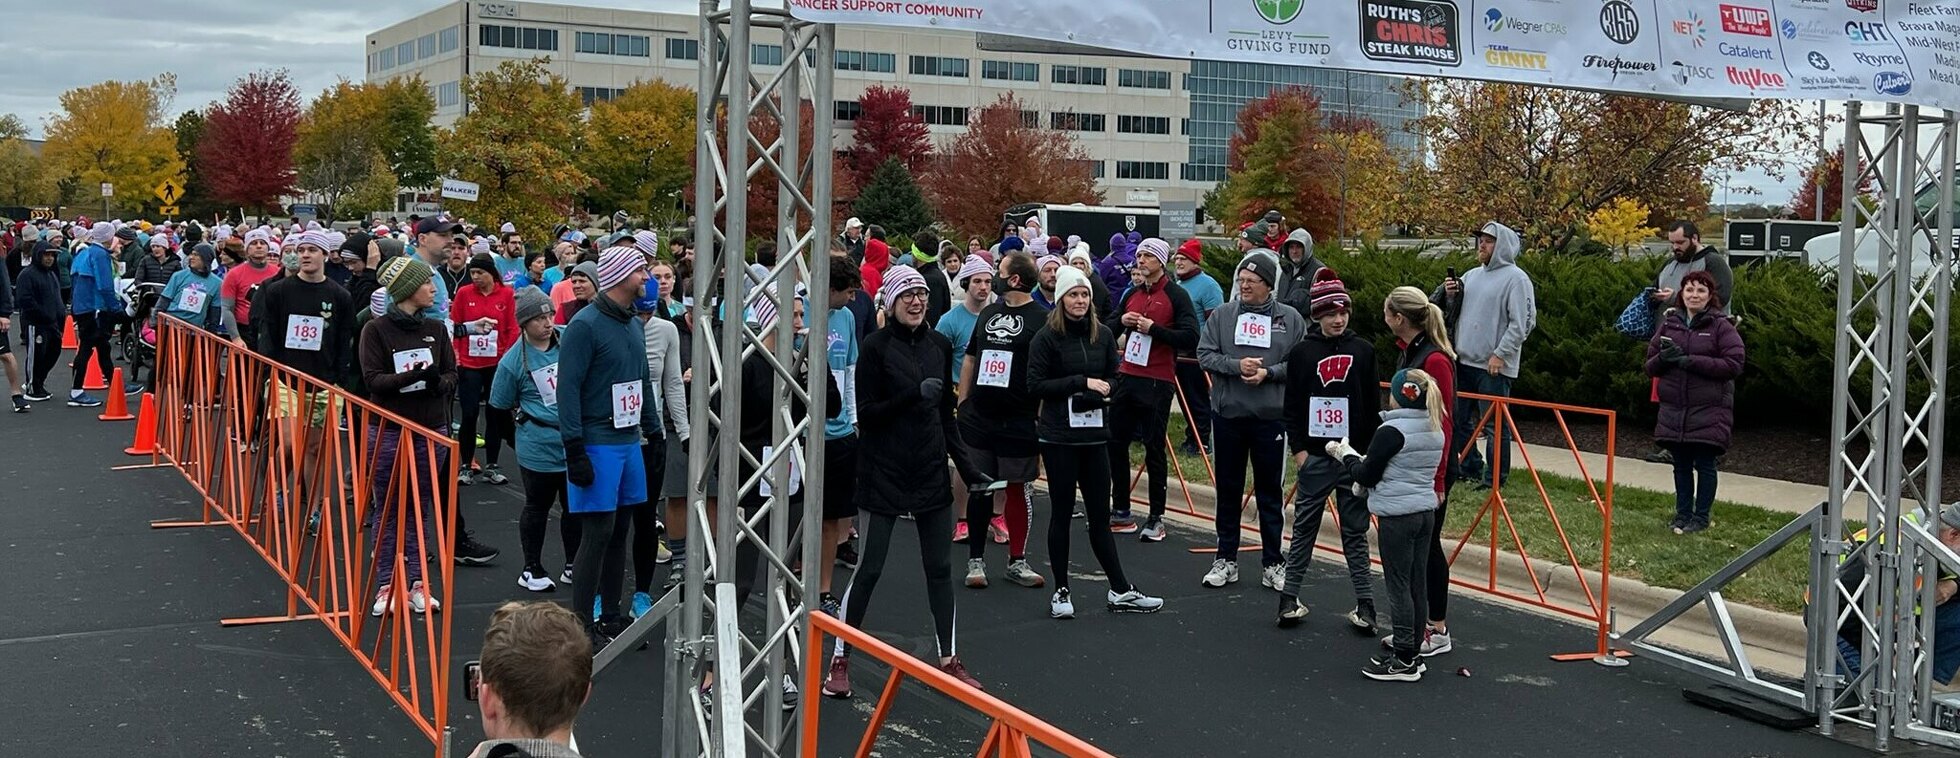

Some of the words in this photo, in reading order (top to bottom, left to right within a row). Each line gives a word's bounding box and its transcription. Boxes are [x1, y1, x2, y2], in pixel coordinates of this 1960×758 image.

[842, 0, 902, 14] SUPPORT
[905, 4, 983, 19] COMMUNITY
[1368, 3, 1421, 22] RUTH'S
[1909, 3, 1937, 16] Fleet
[1376, 20, 1447, 47] CHRIS
[1673, 20, 1693, 35] NET
[1898, 21, 1935, 32] Brava
[1262, 30, 1293, 40] LEVY
[1227, 39, 1283, 53] GIVING
[1289, 42, 1331, 55] FUND
[1367, 41, 1411, 55] STEAK
[1414, 45, 1455, 60] HOUSE
[1718, 42, 1774, 60] Catalent
[1906, 36, 1955, 52] Mid-West
[1485, 51, 1547, 70] GINNY
[1583, 54, 1656, 77] Firepower
[1853, 52, 1904, 67] Rhyme
[1685, 64, 1714, 79] TASC
[1929, 68, 1955, 85] Mead
[444, 186, 477, 195] WALKERS
[188, 295, 199, 305] 93
[294, 325, 317, 338] 183
[1242, 321, 1265, 336] 166
[477, 338, 489, 348] 61
[1132, 341, 1141, 353] 71
[985, 360, 1006, 374] 169
[621, 394, 641, 412] 134
[1316, 409, 1343, 424] 138
